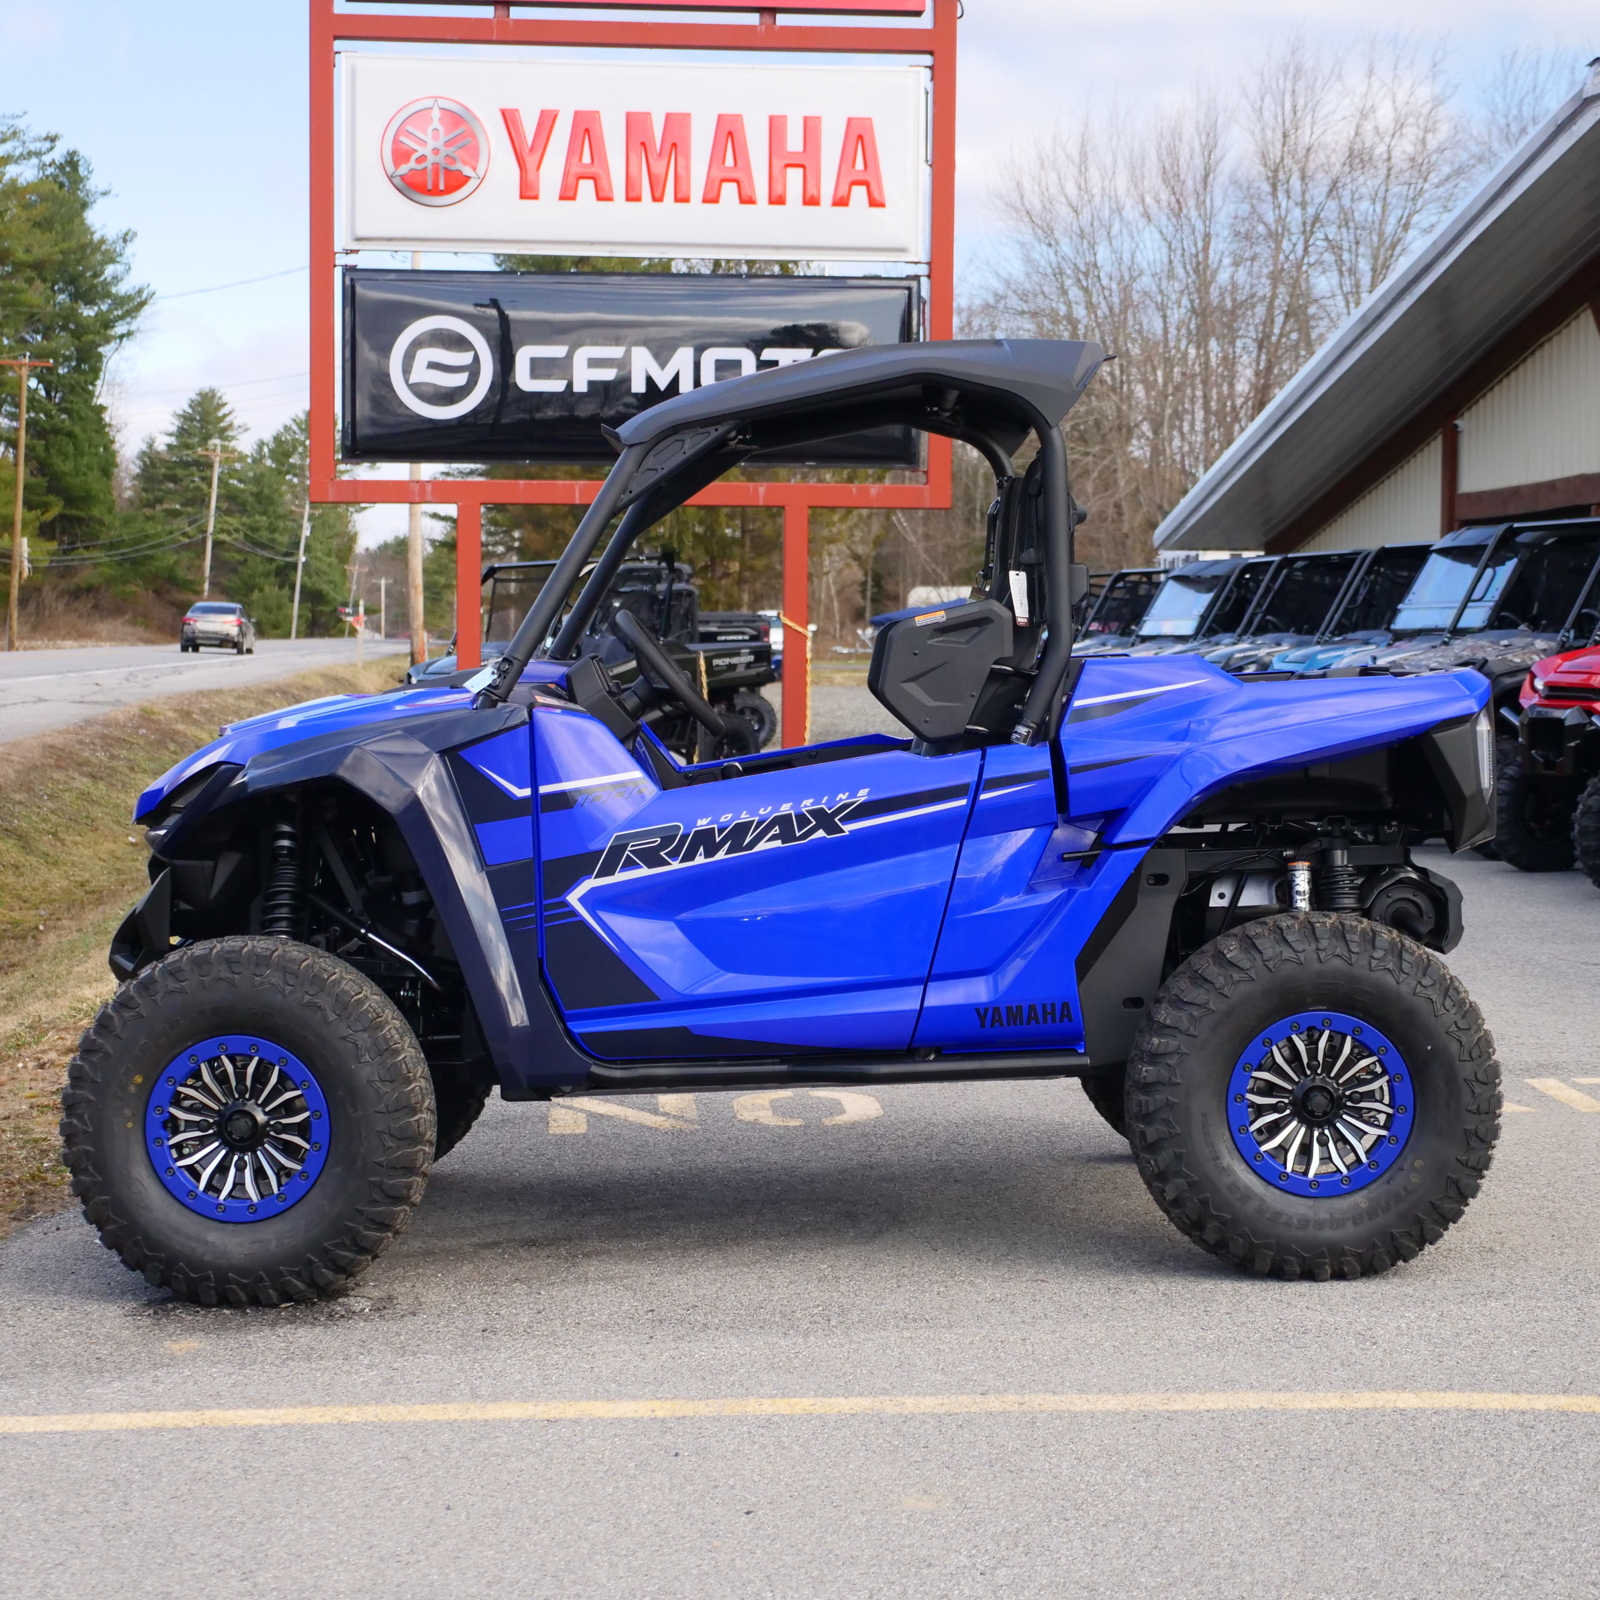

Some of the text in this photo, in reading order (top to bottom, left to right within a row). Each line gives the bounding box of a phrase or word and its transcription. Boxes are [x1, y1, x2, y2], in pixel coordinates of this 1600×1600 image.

[500, 107, 887, 208] YAMAHA
[515, 345, 853, 393] CFMOT
[712, 655, 755, 667] PIONEER
[591, 796, 868, 880] RMAX
[1291, 872, 1309, 910] FOX
[975, 1001, 1074, 1029] YAMAHA
[548, 1091, 883, 1134] NO
